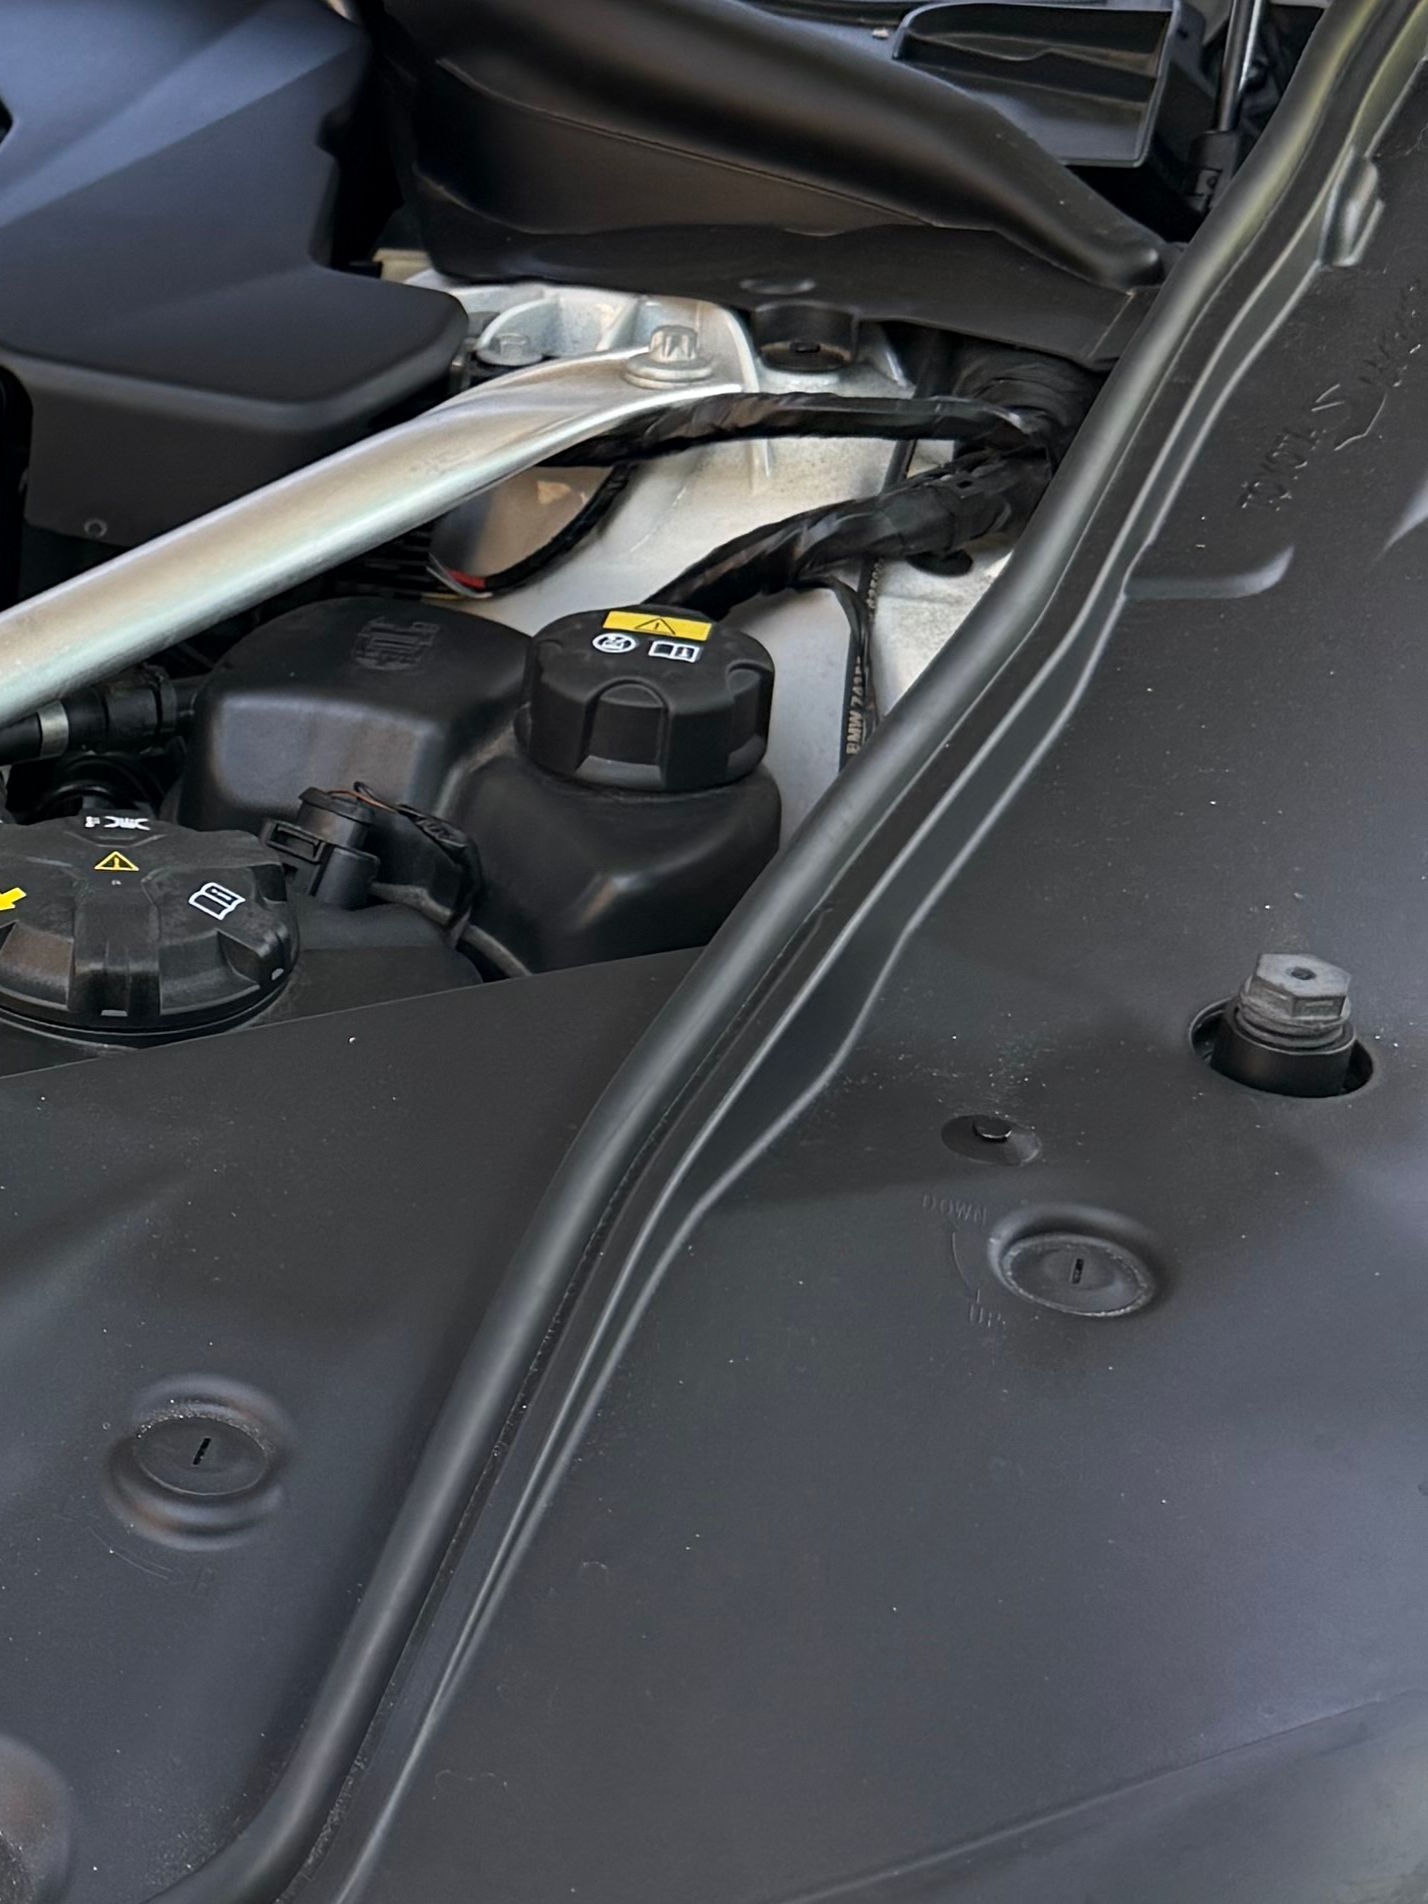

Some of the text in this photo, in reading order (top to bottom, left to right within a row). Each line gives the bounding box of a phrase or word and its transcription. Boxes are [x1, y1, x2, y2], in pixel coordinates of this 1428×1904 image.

[846, 710, 864, 755] BMW
[921, 1193, 987, 1228] DOWN
[968, 1304, 1003, 1328] UP
